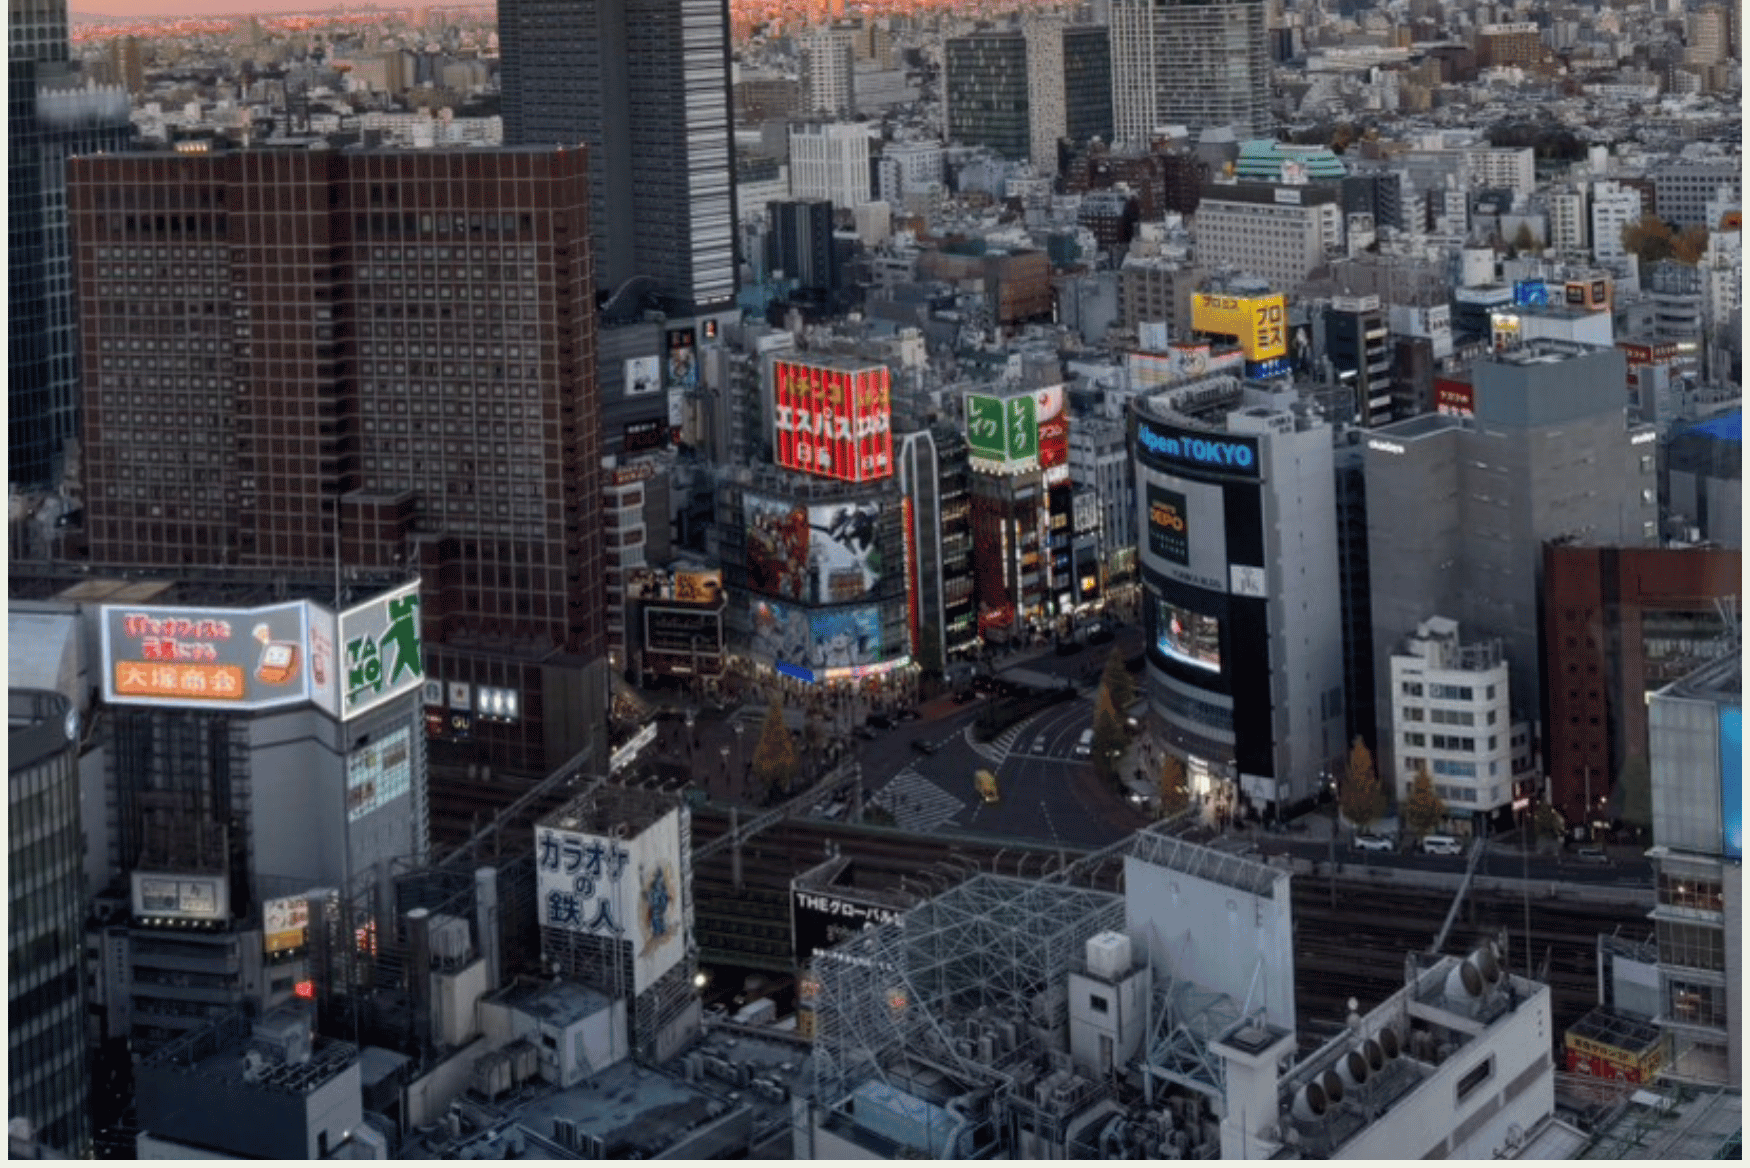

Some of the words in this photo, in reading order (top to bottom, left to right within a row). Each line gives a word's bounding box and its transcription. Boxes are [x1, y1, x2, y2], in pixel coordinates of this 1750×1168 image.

[775, 404, 852, 441] エスパス
[1181, 436, 1252, 467] TOKYO
[121, 665, 237, 692] 大塚商会
[451, 715, 470, 730] GU
[541, 833, 629, 880] カラオケ
[574, 875, 594, 898] の
[548, 891, 625, 932] 鉄人
